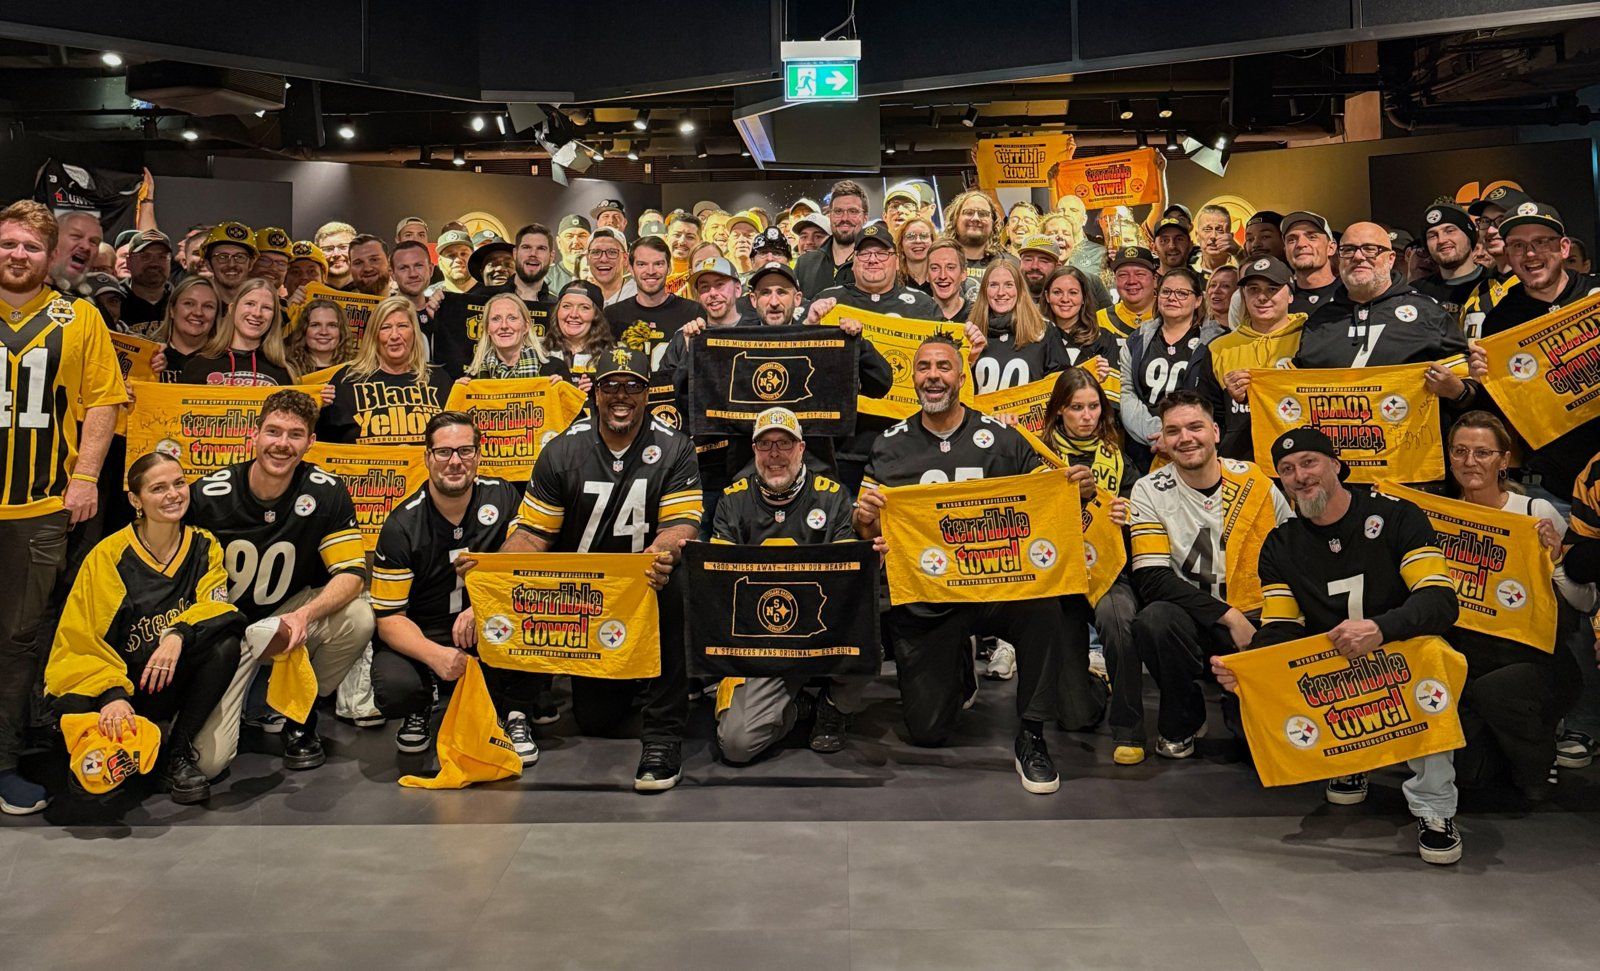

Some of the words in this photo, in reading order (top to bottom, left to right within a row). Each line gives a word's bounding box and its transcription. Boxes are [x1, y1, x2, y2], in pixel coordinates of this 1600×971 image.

[995, 148, 1046, 164] terrible
[1003, 164, 1039, 179] towel
[1092, 179, 1127, 196] towel
[353, 381, 441, 412] Black
[412, 406, 443, 415] AND
[467, 401, 544, 430] terrible
[190, 436, 256, 467] towel
[480, 429, 534, 458] towel
[1091, 466, 1117, 492] BVB
[355, 498, 392, 525] wel
[577, 478, 650, 553] 74
[939, 506, 1031, 544] terrible
[955, 537, 1022, 575] towel
[1435, 529, 1507, 572] rrible
[225, 539, 296, 606] 90
[809, 563, 821, 571] OUR
[512, 582, 603, 617] terrible
[1327, 574, 1364, 621] 7
[125, 598, 190, 652] Steel
[522, 614, 589, 649] towel
[722, 648, 756, 656] STEELERS
[780, 649, 812, 657] ORIGINAL
[1296, 654, 1320, 666] MYRON
[1297, 649, 1412, 708] terrible
[1323, 685, 1412, 741] towel
[1396, 724, 1427, 738] ORIGINAL
